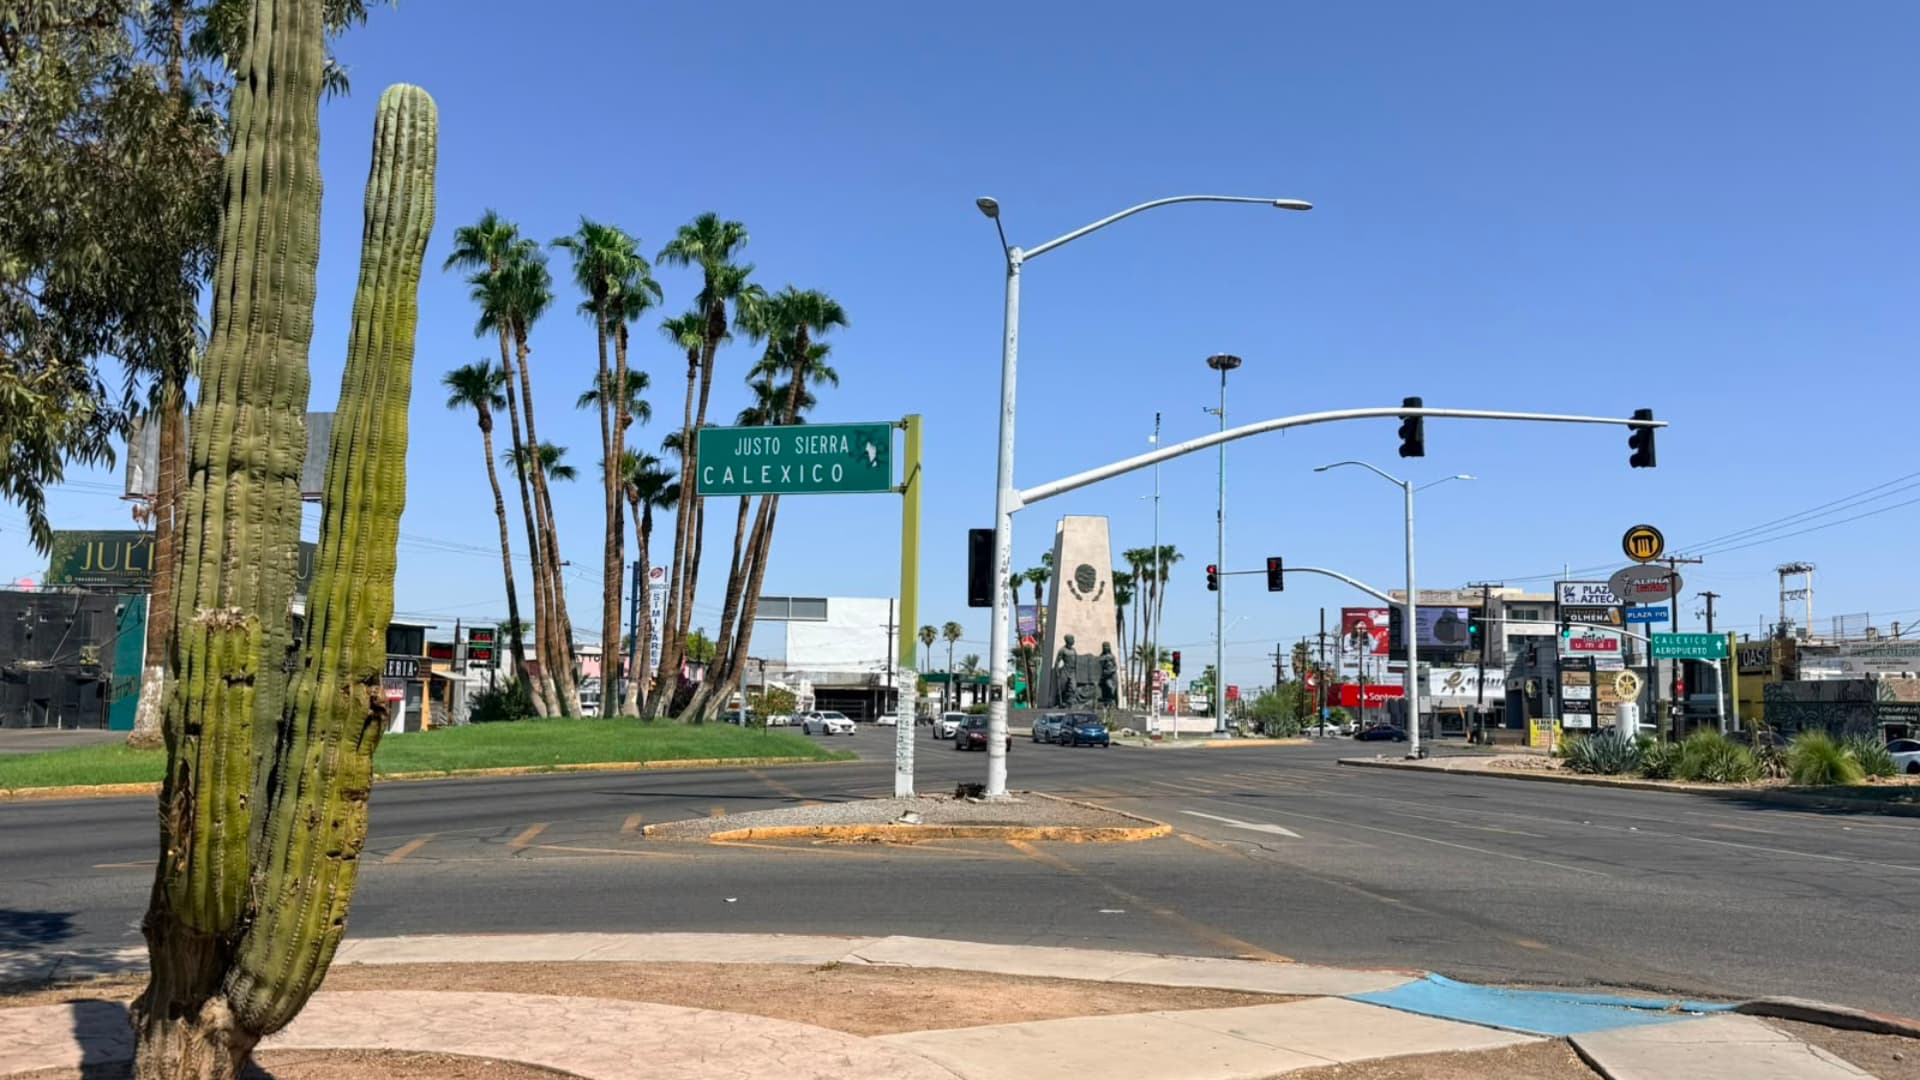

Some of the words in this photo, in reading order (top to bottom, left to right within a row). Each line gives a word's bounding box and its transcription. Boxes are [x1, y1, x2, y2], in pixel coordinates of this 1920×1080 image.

[734, 437, 781, 456] JUSTO
[795, 434, 849, 455] SIERRA
[703, 463, 844, 485] CALEXICO
[1580, 594, 1618, 604] AZTECA
[1654, 636, 1708, 645] CALEXICO
[1655, 646, 1708, 655] AEROPUERTO
